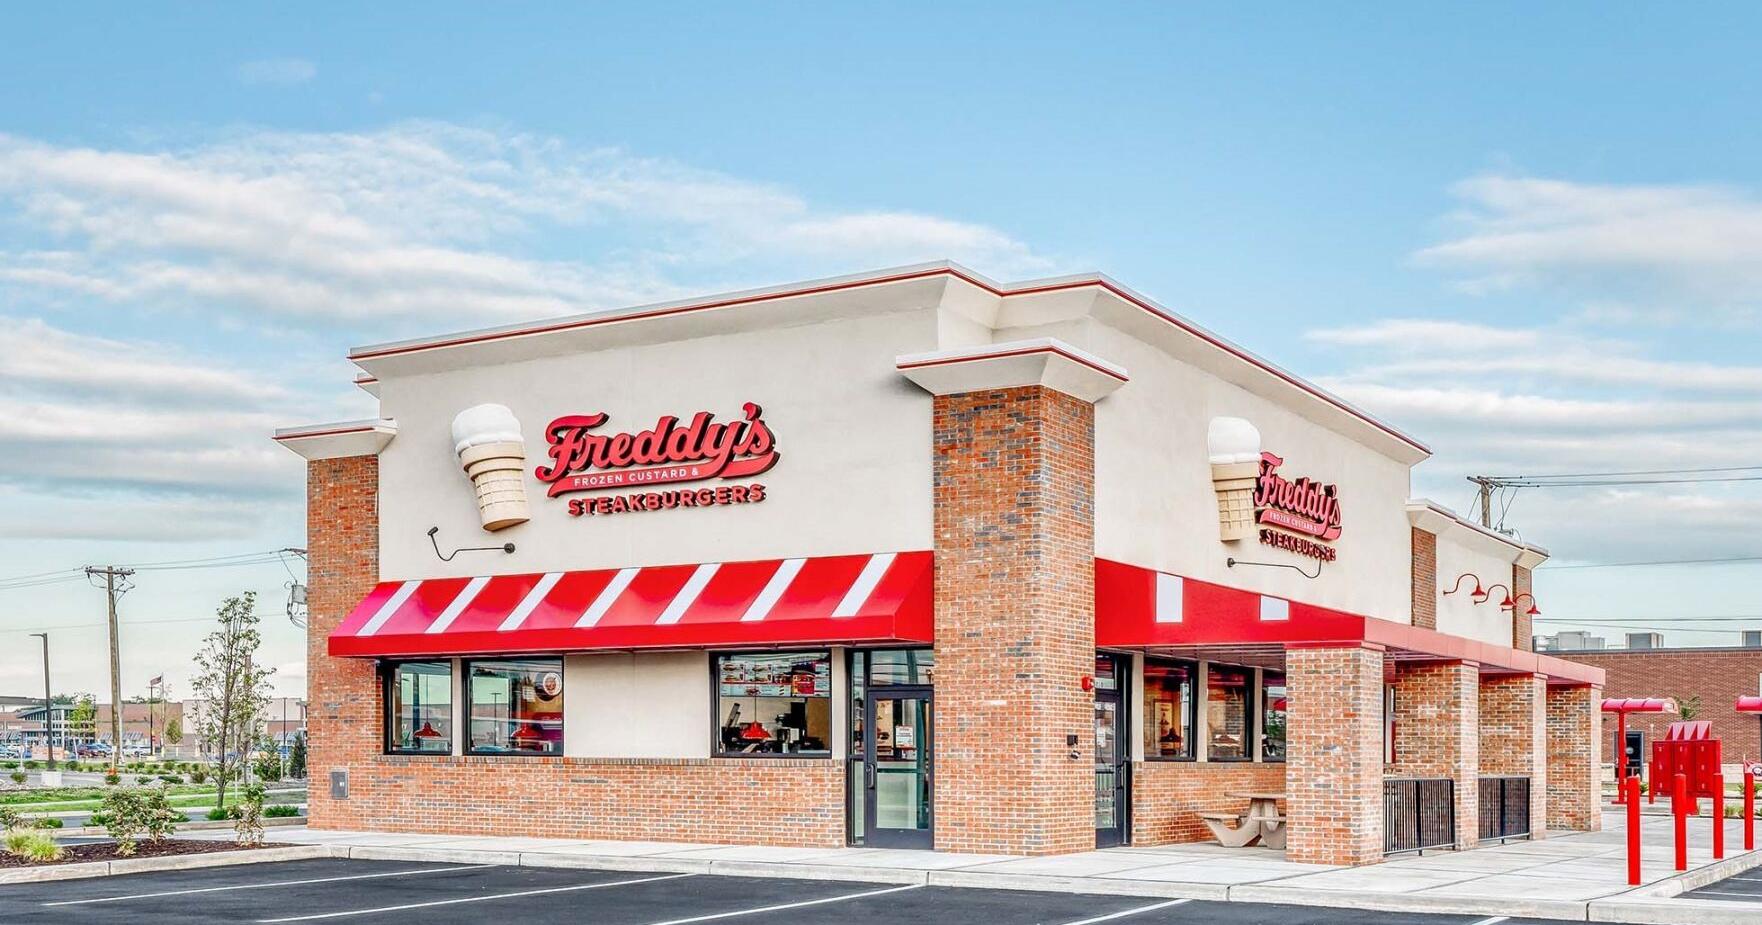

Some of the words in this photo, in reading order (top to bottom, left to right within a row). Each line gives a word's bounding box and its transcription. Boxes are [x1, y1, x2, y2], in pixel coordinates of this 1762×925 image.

[535, 401, 780, 497] Freddy's
[574, 474, 623, 487] FROZEN
[628, 468, 687, 482] CUSTARD
[691, 467, 699, 476] &
[568, 483, 766, 517] STEAKBURGERS
[1254, 451, 1342, 540] Freddy's
[1259, 529, 1336, 561] STEAKBURGRS
